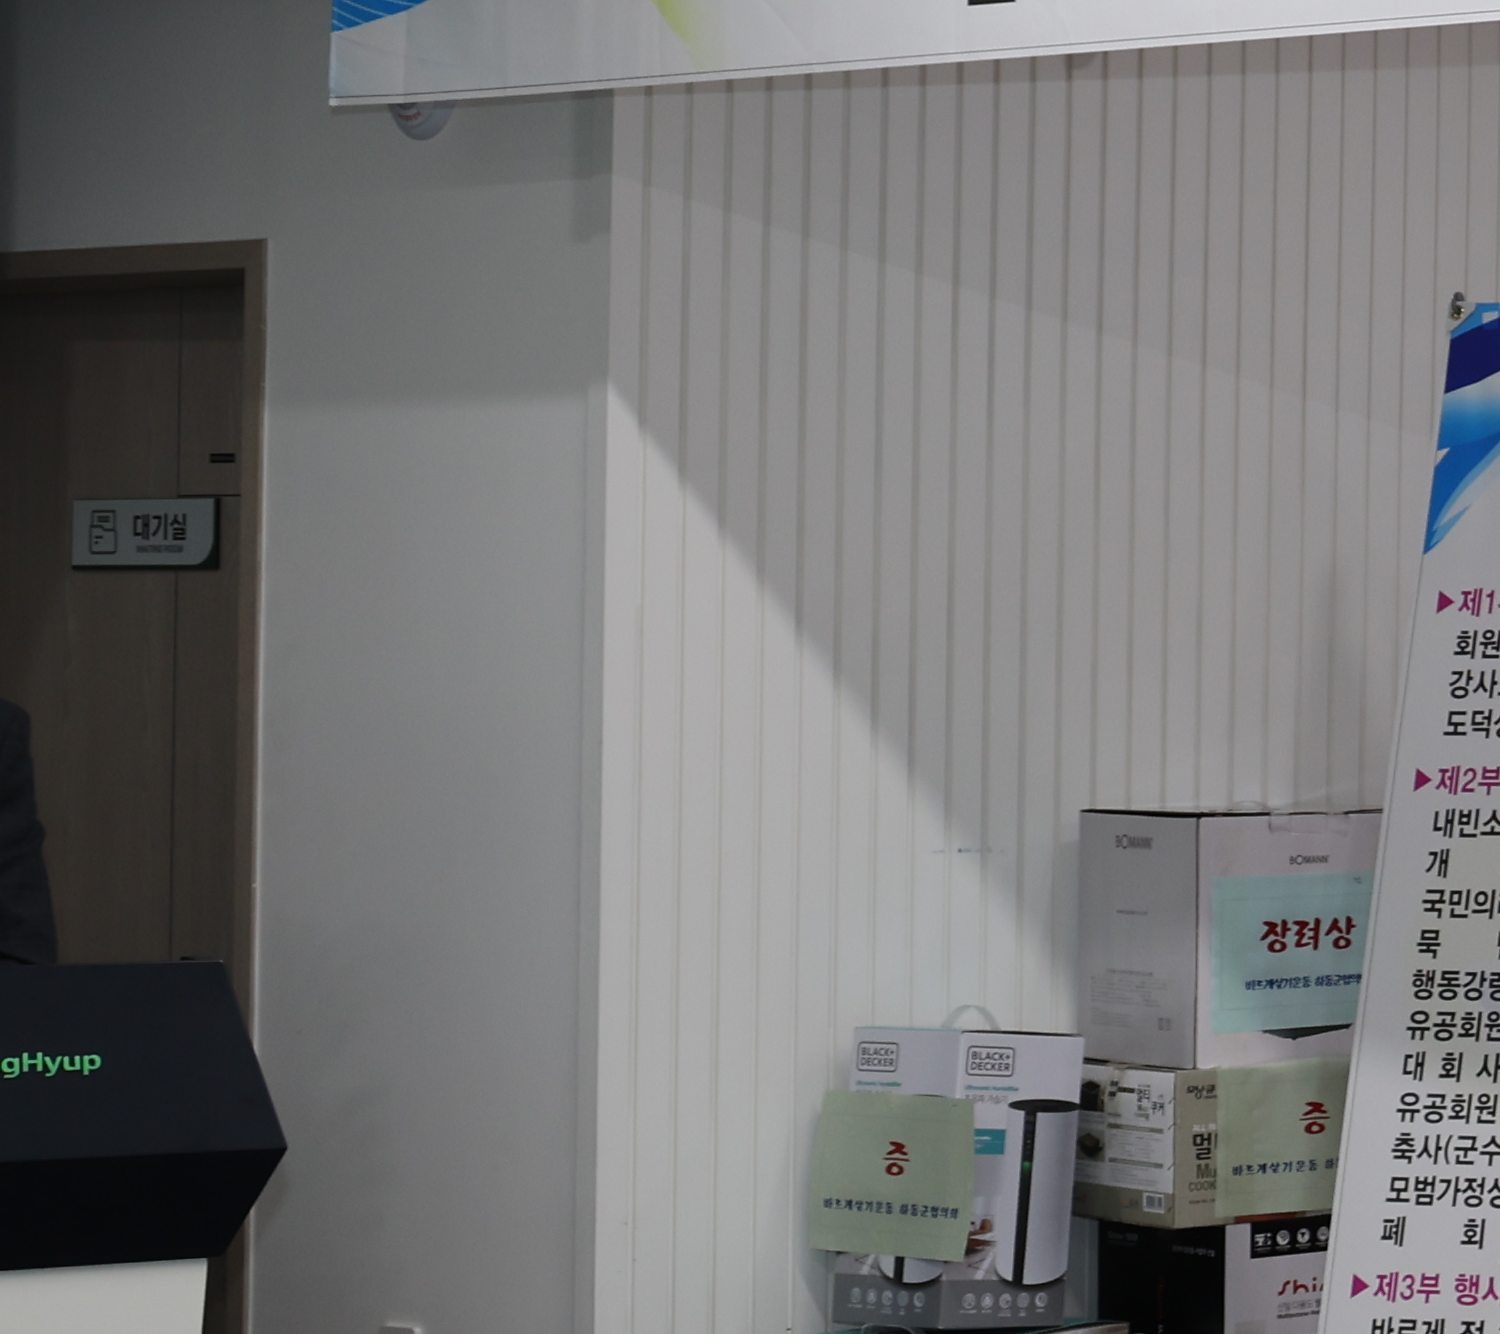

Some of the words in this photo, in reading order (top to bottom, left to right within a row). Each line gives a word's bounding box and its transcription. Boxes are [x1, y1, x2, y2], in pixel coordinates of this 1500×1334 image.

[132, 513, 187, 542] 대기실
[1260, 916, 1356, 953] 장려상
[1299, 1102, 1330, 1134] 증
[1396, 1093, 1498, 1125] 유공회원
[883, 1141, 909, 1176] 증
[899, 1203, 958, 1220] 하동군협의회
[1374, 1273, 1443, 1304] 제3부
